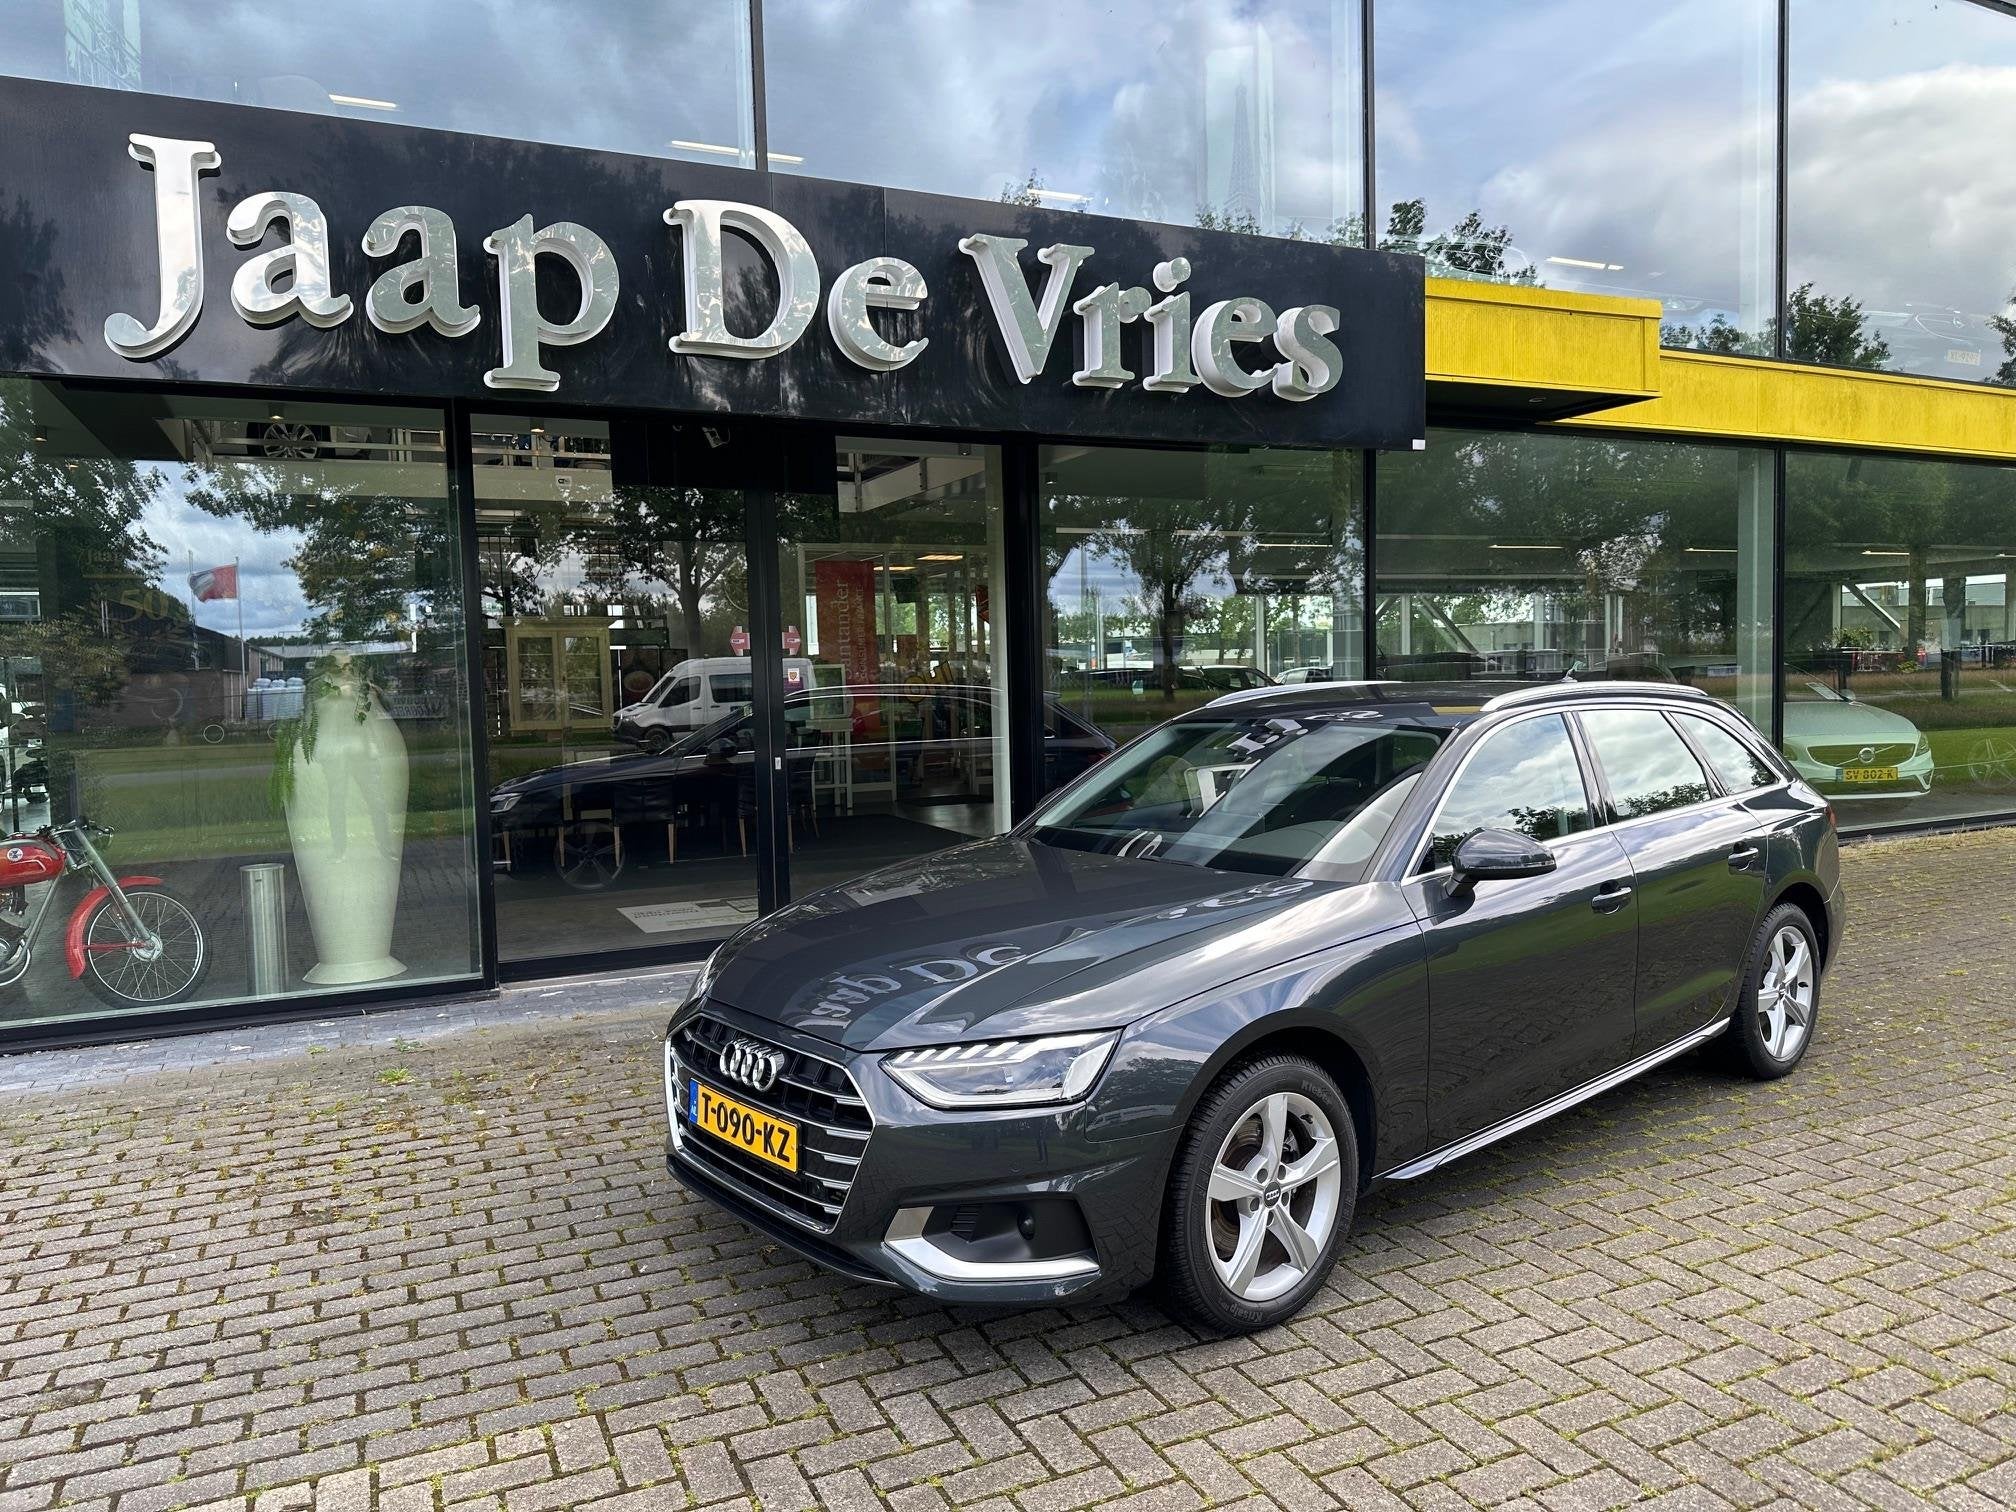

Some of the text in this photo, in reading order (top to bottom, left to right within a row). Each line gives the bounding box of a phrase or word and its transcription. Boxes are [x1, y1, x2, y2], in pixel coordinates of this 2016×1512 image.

[103, 132, 1343, 401] Jaap De Vries
[702, 1092, 790, 1162] T-090-KZ
